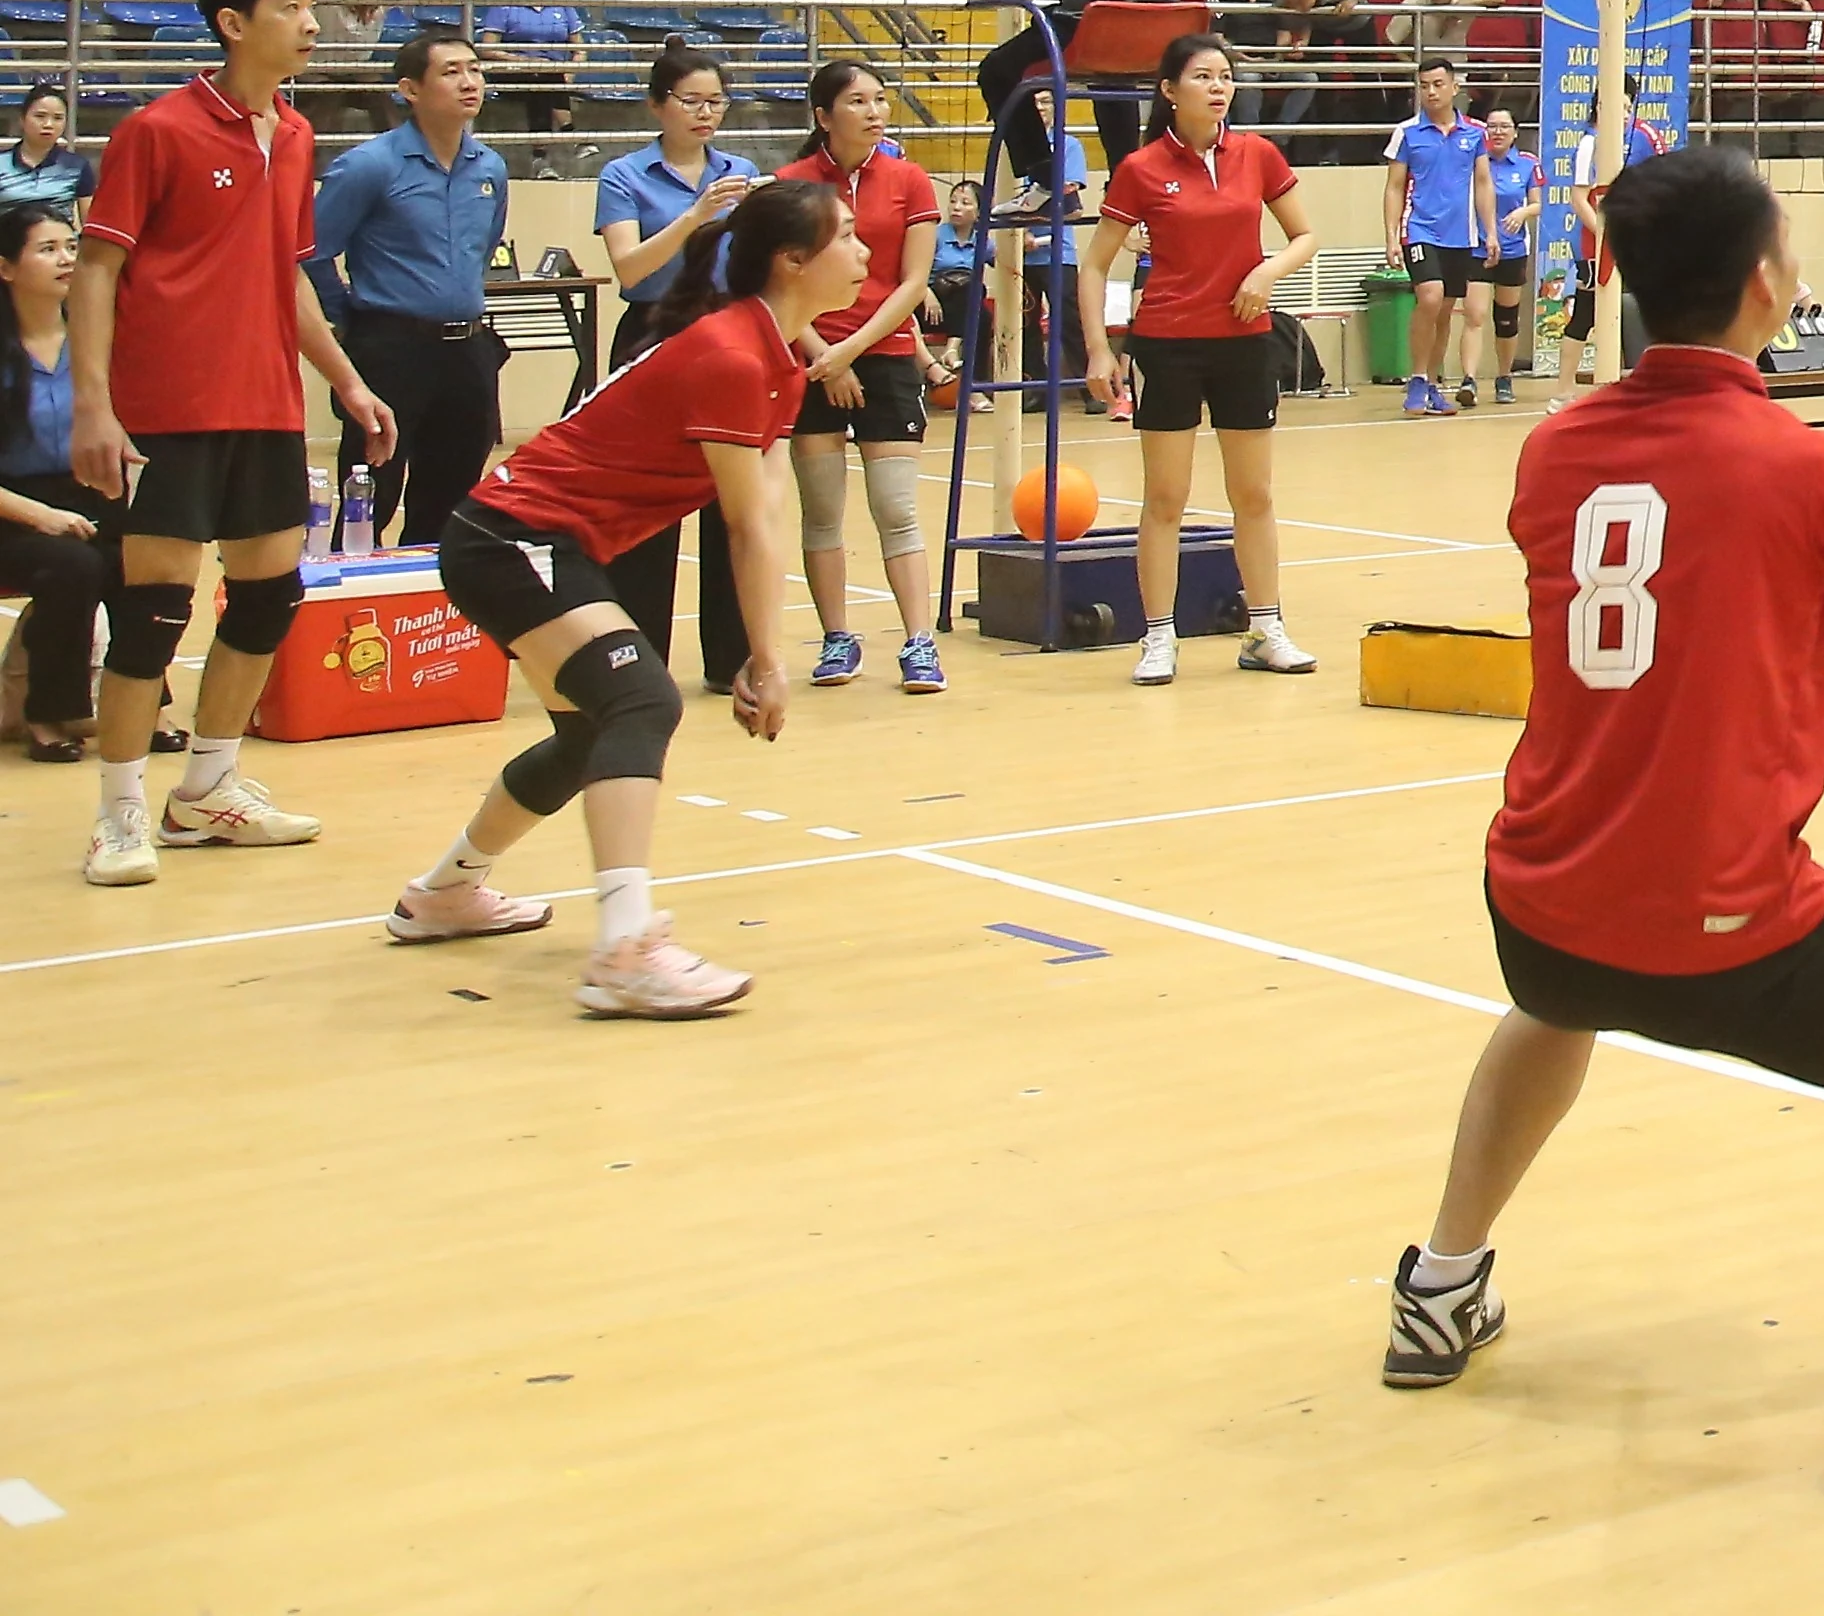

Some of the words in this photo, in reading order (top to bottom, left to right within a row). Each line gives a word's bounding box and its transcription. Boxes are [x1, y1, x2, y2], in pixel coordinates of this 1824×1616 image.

[1567, 44, 1589, 67] XÂY
[1646, 42, 1669, 67] CẤP
[1560, 71, 1590, 95] CÔNG
[1648, 75, 1674, 94] NAM
[1561, 99, 1588, 125] HIỆN
[1568, 482, 1669, 690] 8
[394, 605, 443, 636] Thanh
[408, 633, 443, 658] Tươi
[445, 623, 480, 646] mát
